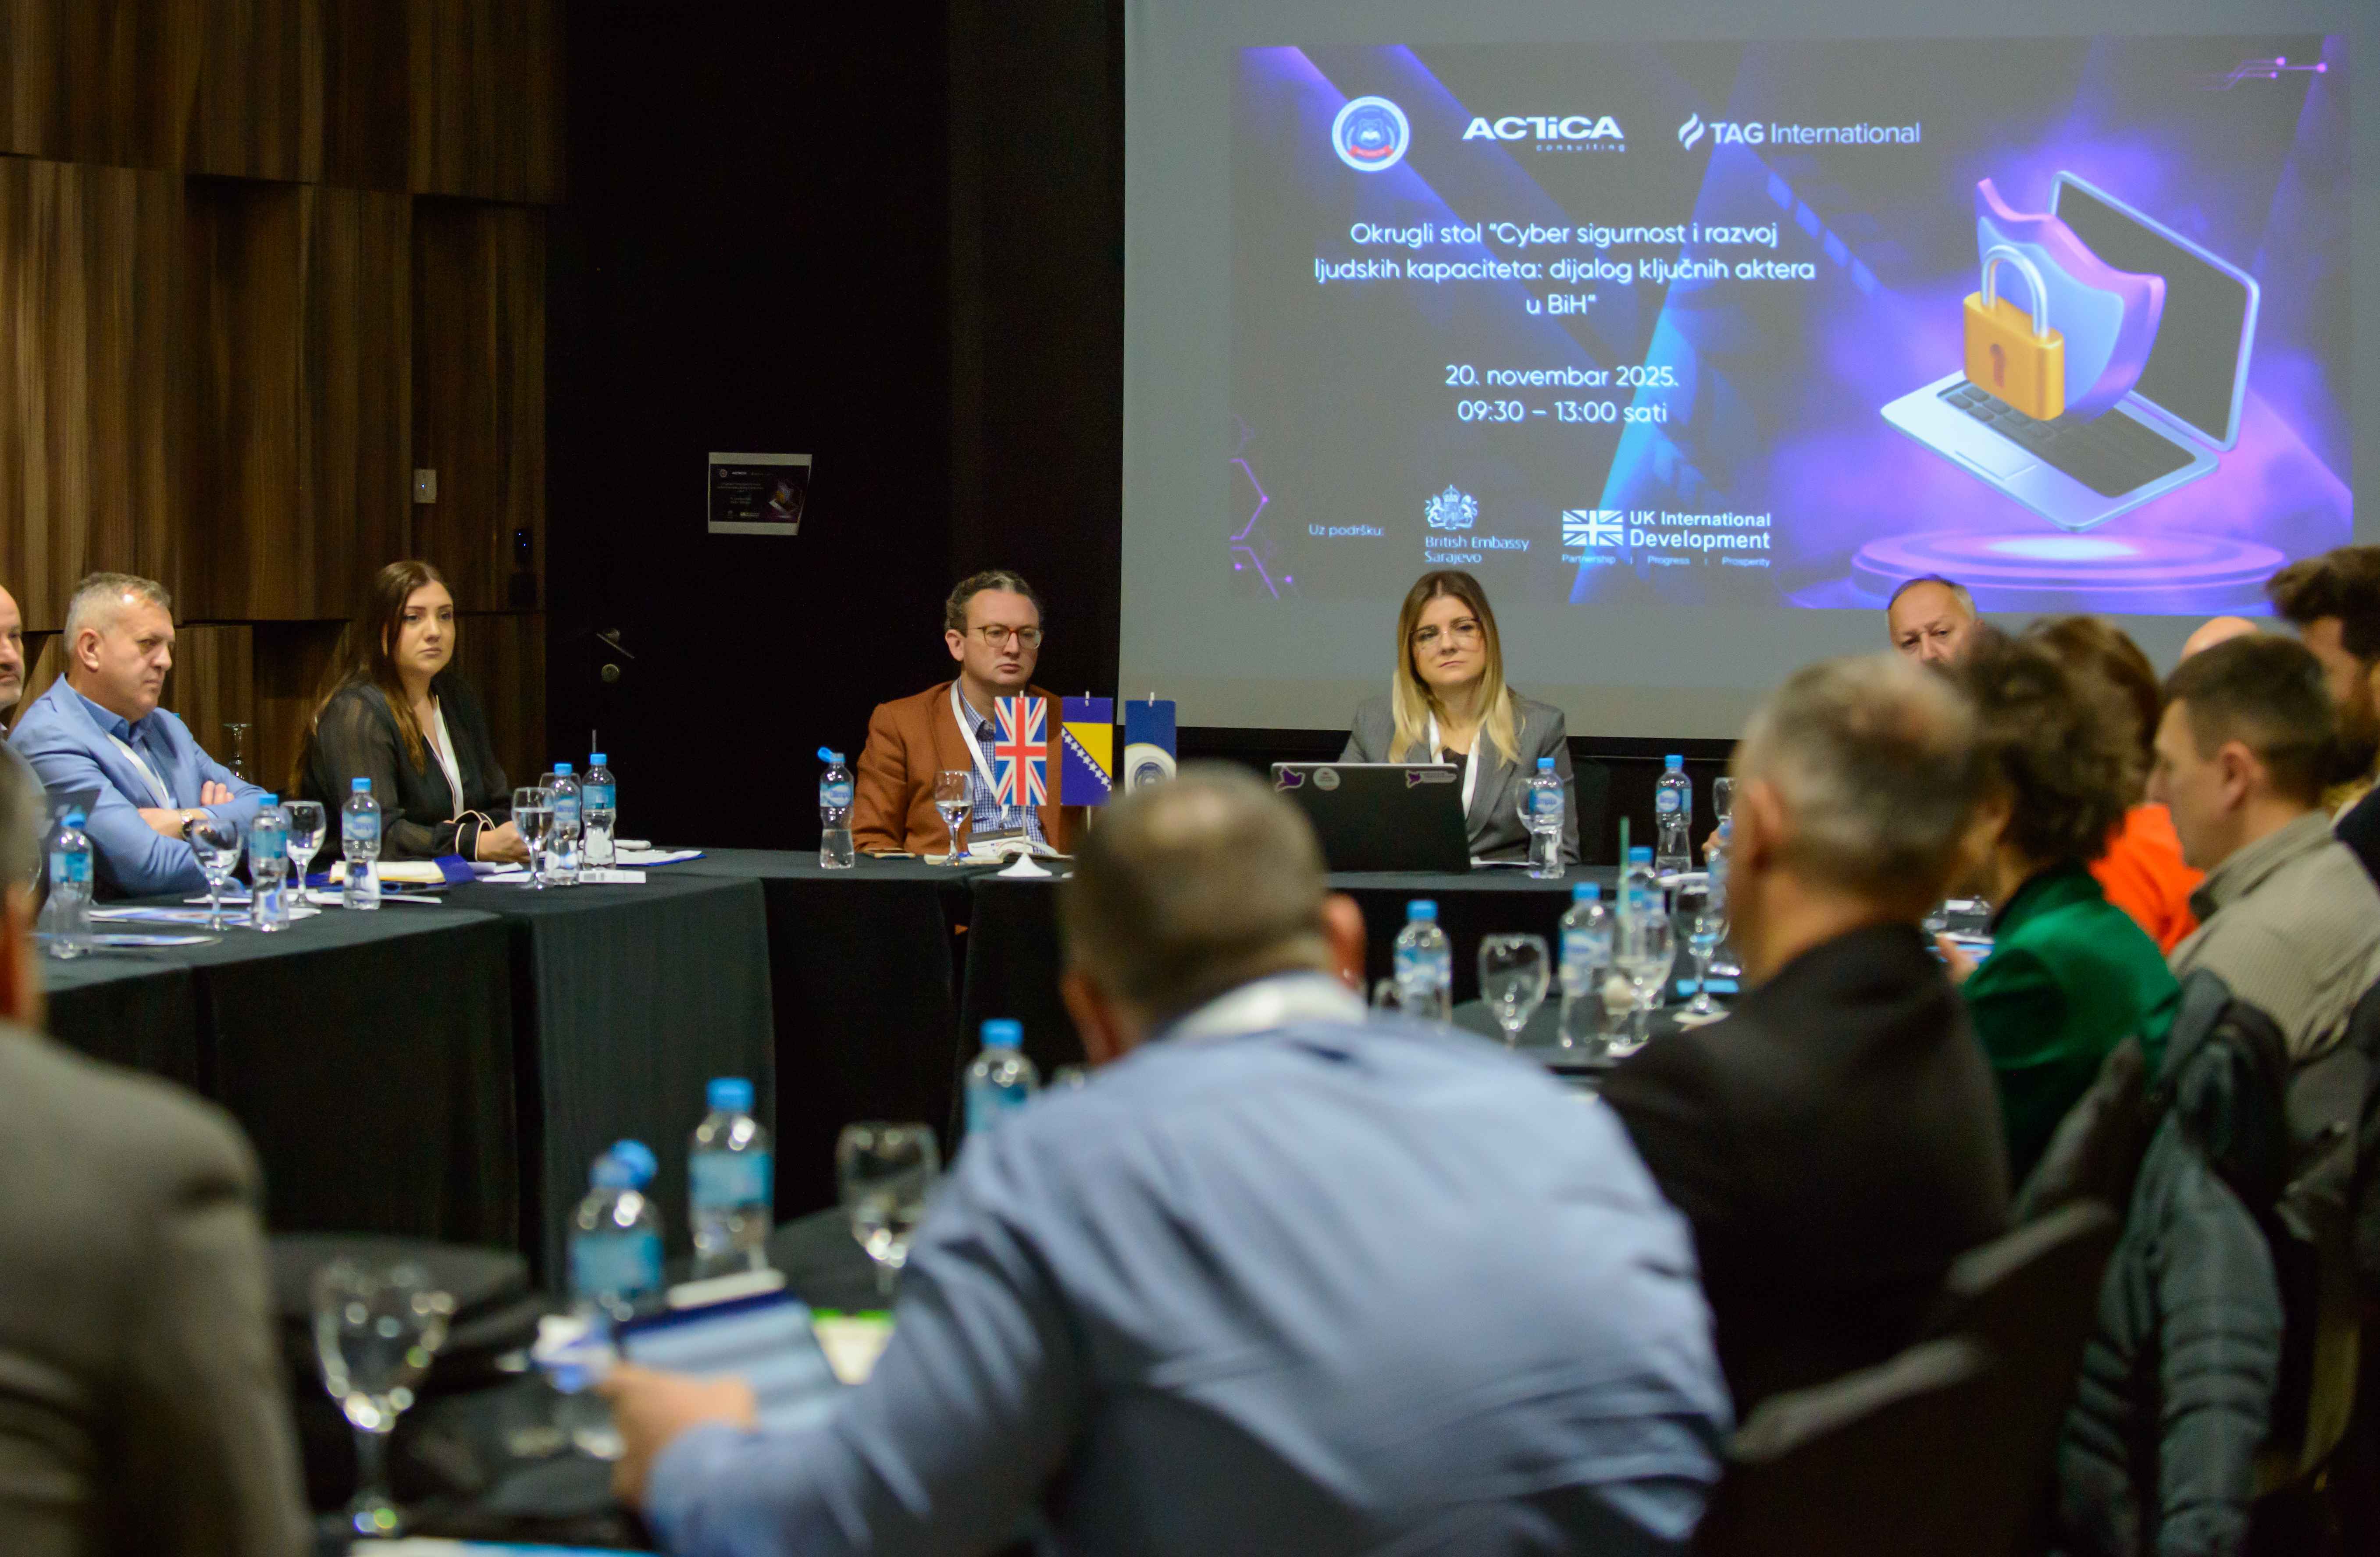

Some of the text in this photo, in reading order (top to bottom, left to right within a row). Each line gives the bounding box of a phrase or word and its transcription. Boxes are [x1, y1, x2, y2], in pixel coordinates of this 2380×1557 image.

[1709, 122, 1920, 144] TAG International
[1536, 143, 1625, 152] consulting
[1350, 222, 1433, 249] Okrugli
[1440, 222, 1482, 244] stol
[1577, 222, 1686, 248] sigurnost
[1692, 222, 1699, 242] i
[1705, 222, 1777, 248] razvoj
[1315, 257, 1815, 284] ljudskih kapaciteta: dijalog ključnih aktera
[1526, 299, 1541, 315] u
[1445, 364, 1679, 387] 20. novembar 2025.
[1457, 400, 1524, 422] 09:30
[1554, 401, 1616, 423] 13:00
[1624, 403, 1667, 422] sati
[1630, 511, 1771, 527] UK International
[1308, 524, 1325, 535] Uz
[1425, 535, 1529, 551] British Embassy
[1630, 529, 1770, 552] Development
[1424, 551, 1482, 565] Sarajevo
[1561, 553, 1616, 565] Partnership
[1647, 555, 1690, 566] Progress
[1721, 556, 1770, 568] Prosperity
